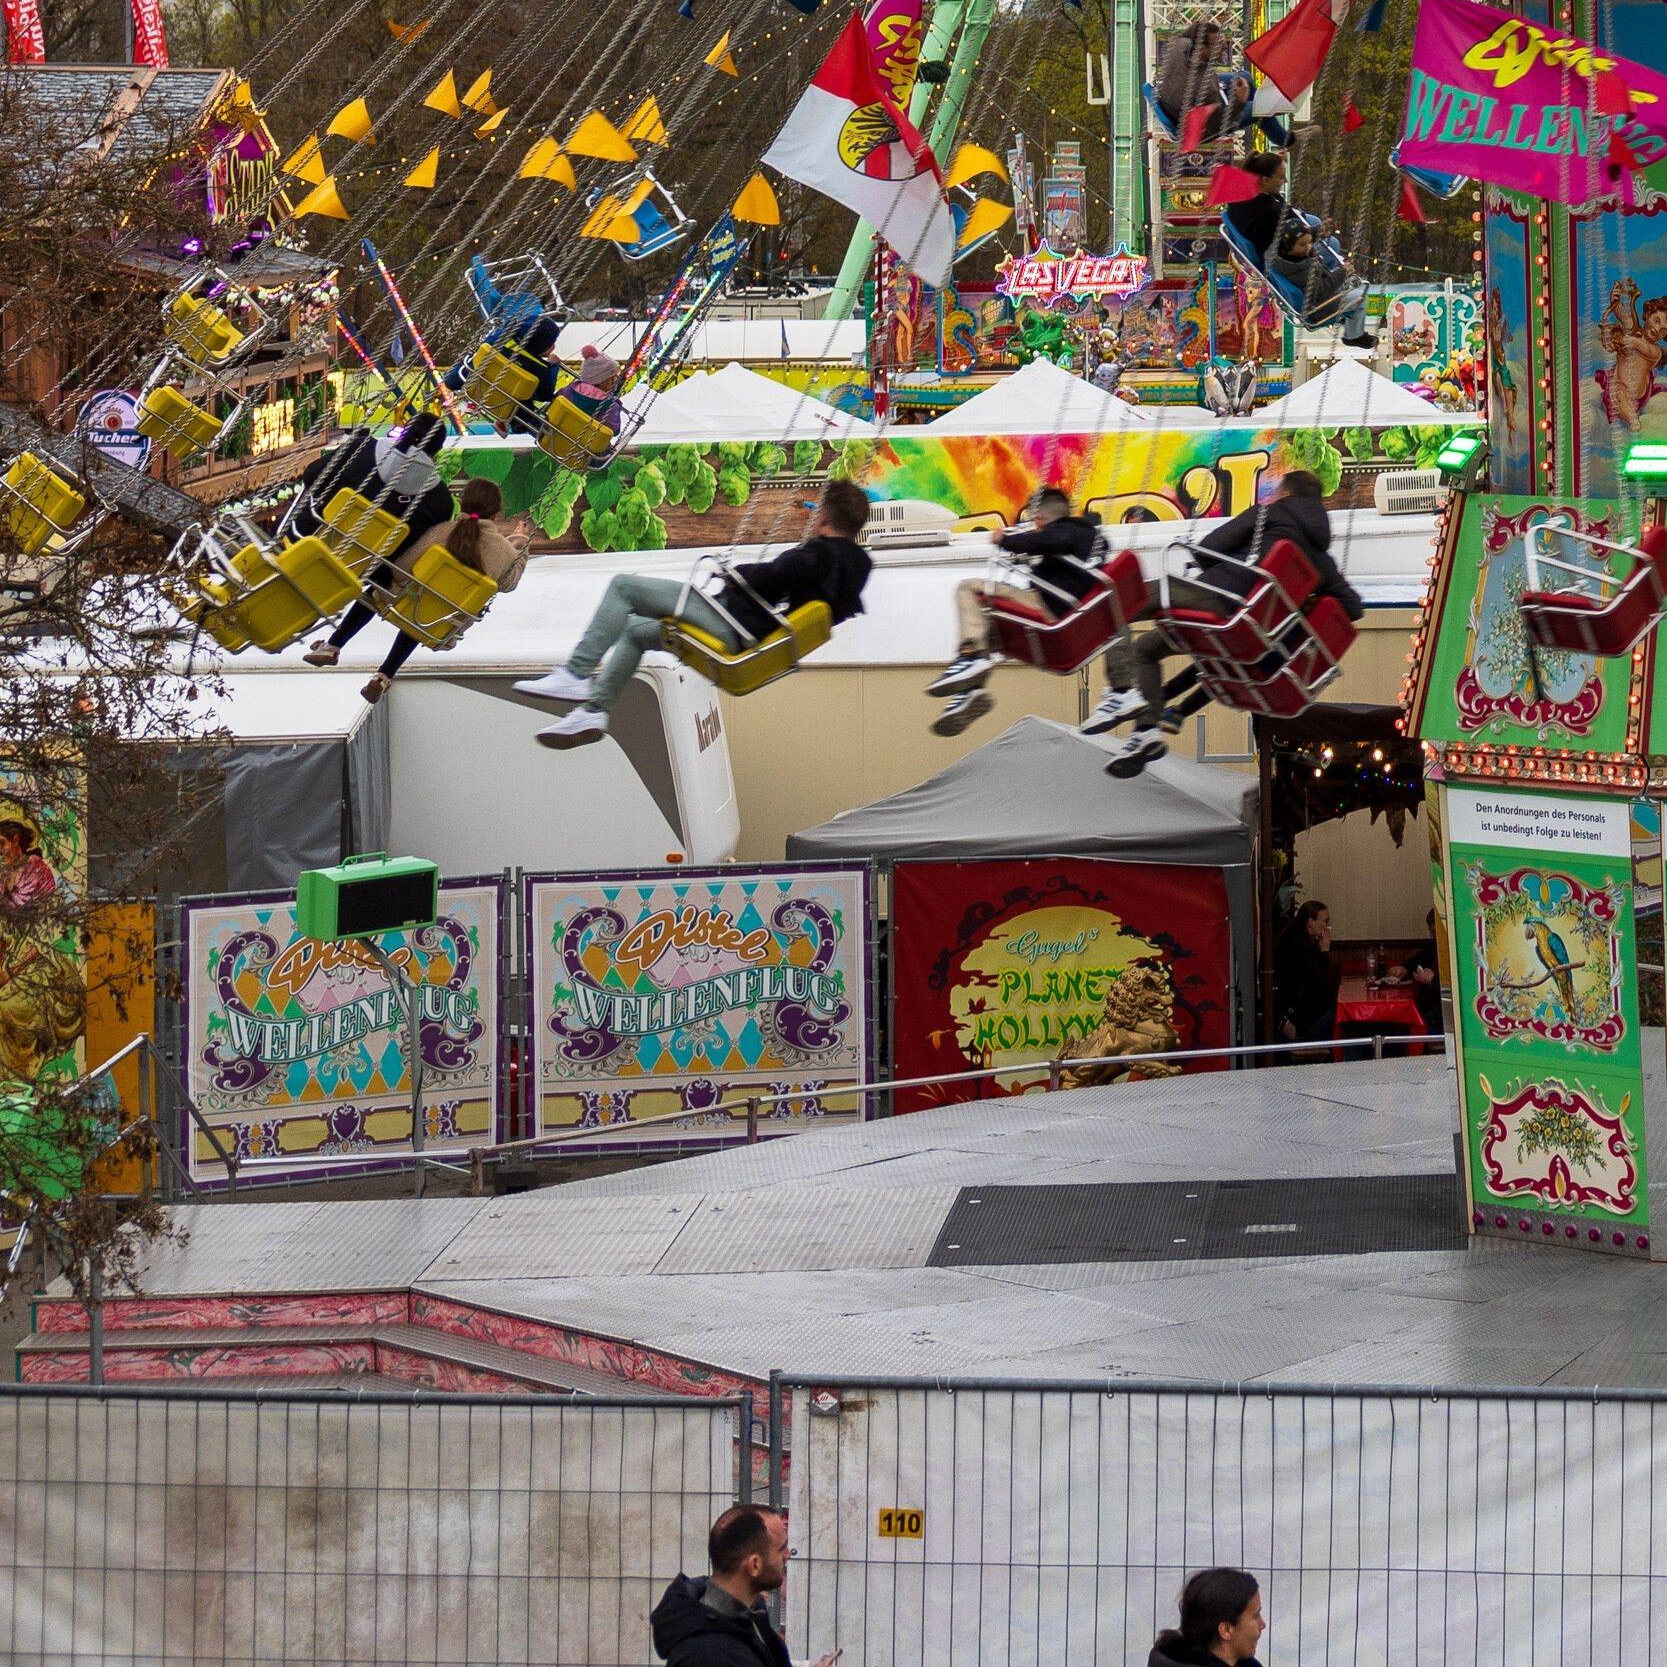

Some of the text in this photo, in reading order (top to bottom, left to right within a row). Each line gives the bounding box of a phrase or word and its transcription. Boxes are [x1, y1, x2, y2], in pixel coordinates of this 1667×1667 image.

[1008, 260, 1145, 293] LAS VEGAS
[1476, 803, 1606, 823] Den Anordnungen des Personals
[1481, 821, 1602, 841] ist unbedingt Folge zu leisten!
[615, 905, 770, 970] Distel
[569, 965, 839, 1035] WELLENFLUG
[976, 1013, 1105, 1052] HOLLYW
[883, 1512, 921, 1533] 110
